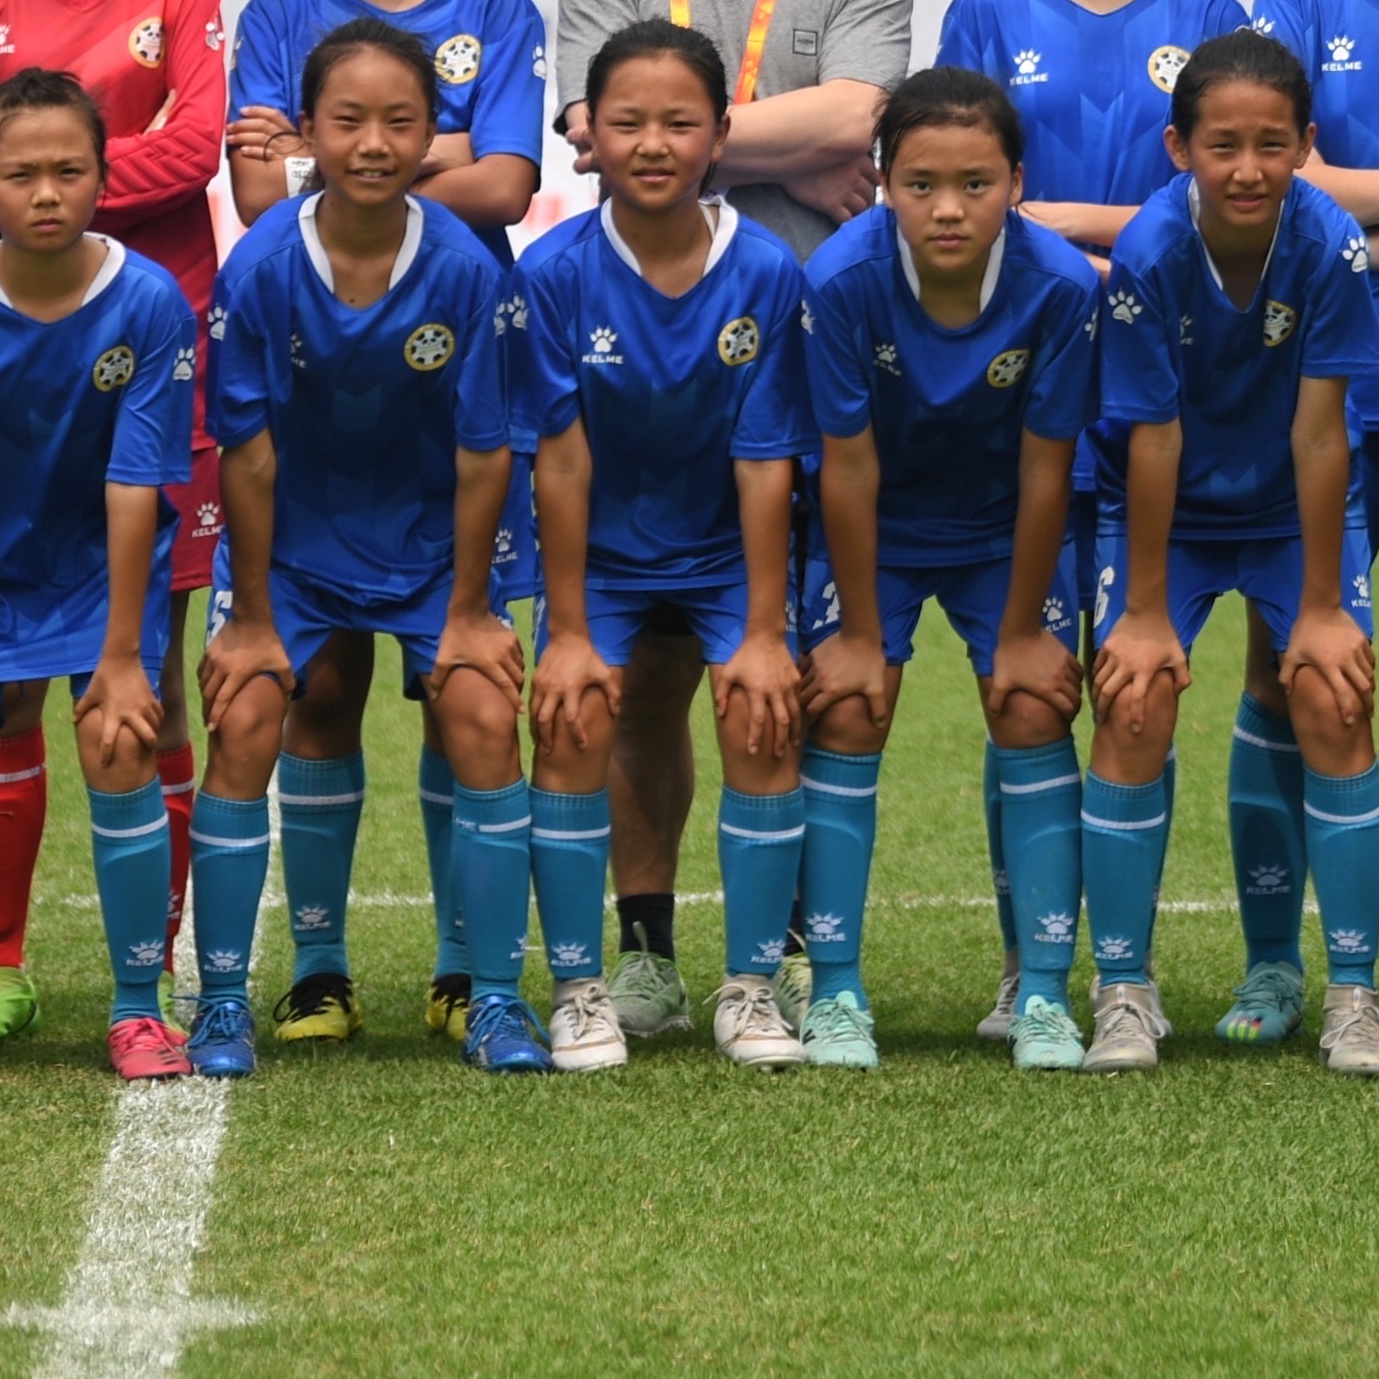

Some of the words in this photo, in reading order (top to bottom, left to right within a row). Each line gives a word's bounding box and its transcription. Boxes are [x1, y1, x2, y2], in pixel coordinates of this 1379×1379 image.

[1321, 61, 1363, 72] KELME
[1009, 73, 1048, 86] KELME
[582, 354, 624, 365] KELME
[1246, 885, 1290, 896] KELME
[294, 920, 330, 931] KELME
[805, 932, 846, 942] KELME
[1034, 932, 1074, 943] KELME
[1329, 944, 1370, 954] KELME
[1095, 950, 1134, 960] KELME
[551, 957, 592, 967] KELME
[204, 963, 243, 973] KELME
